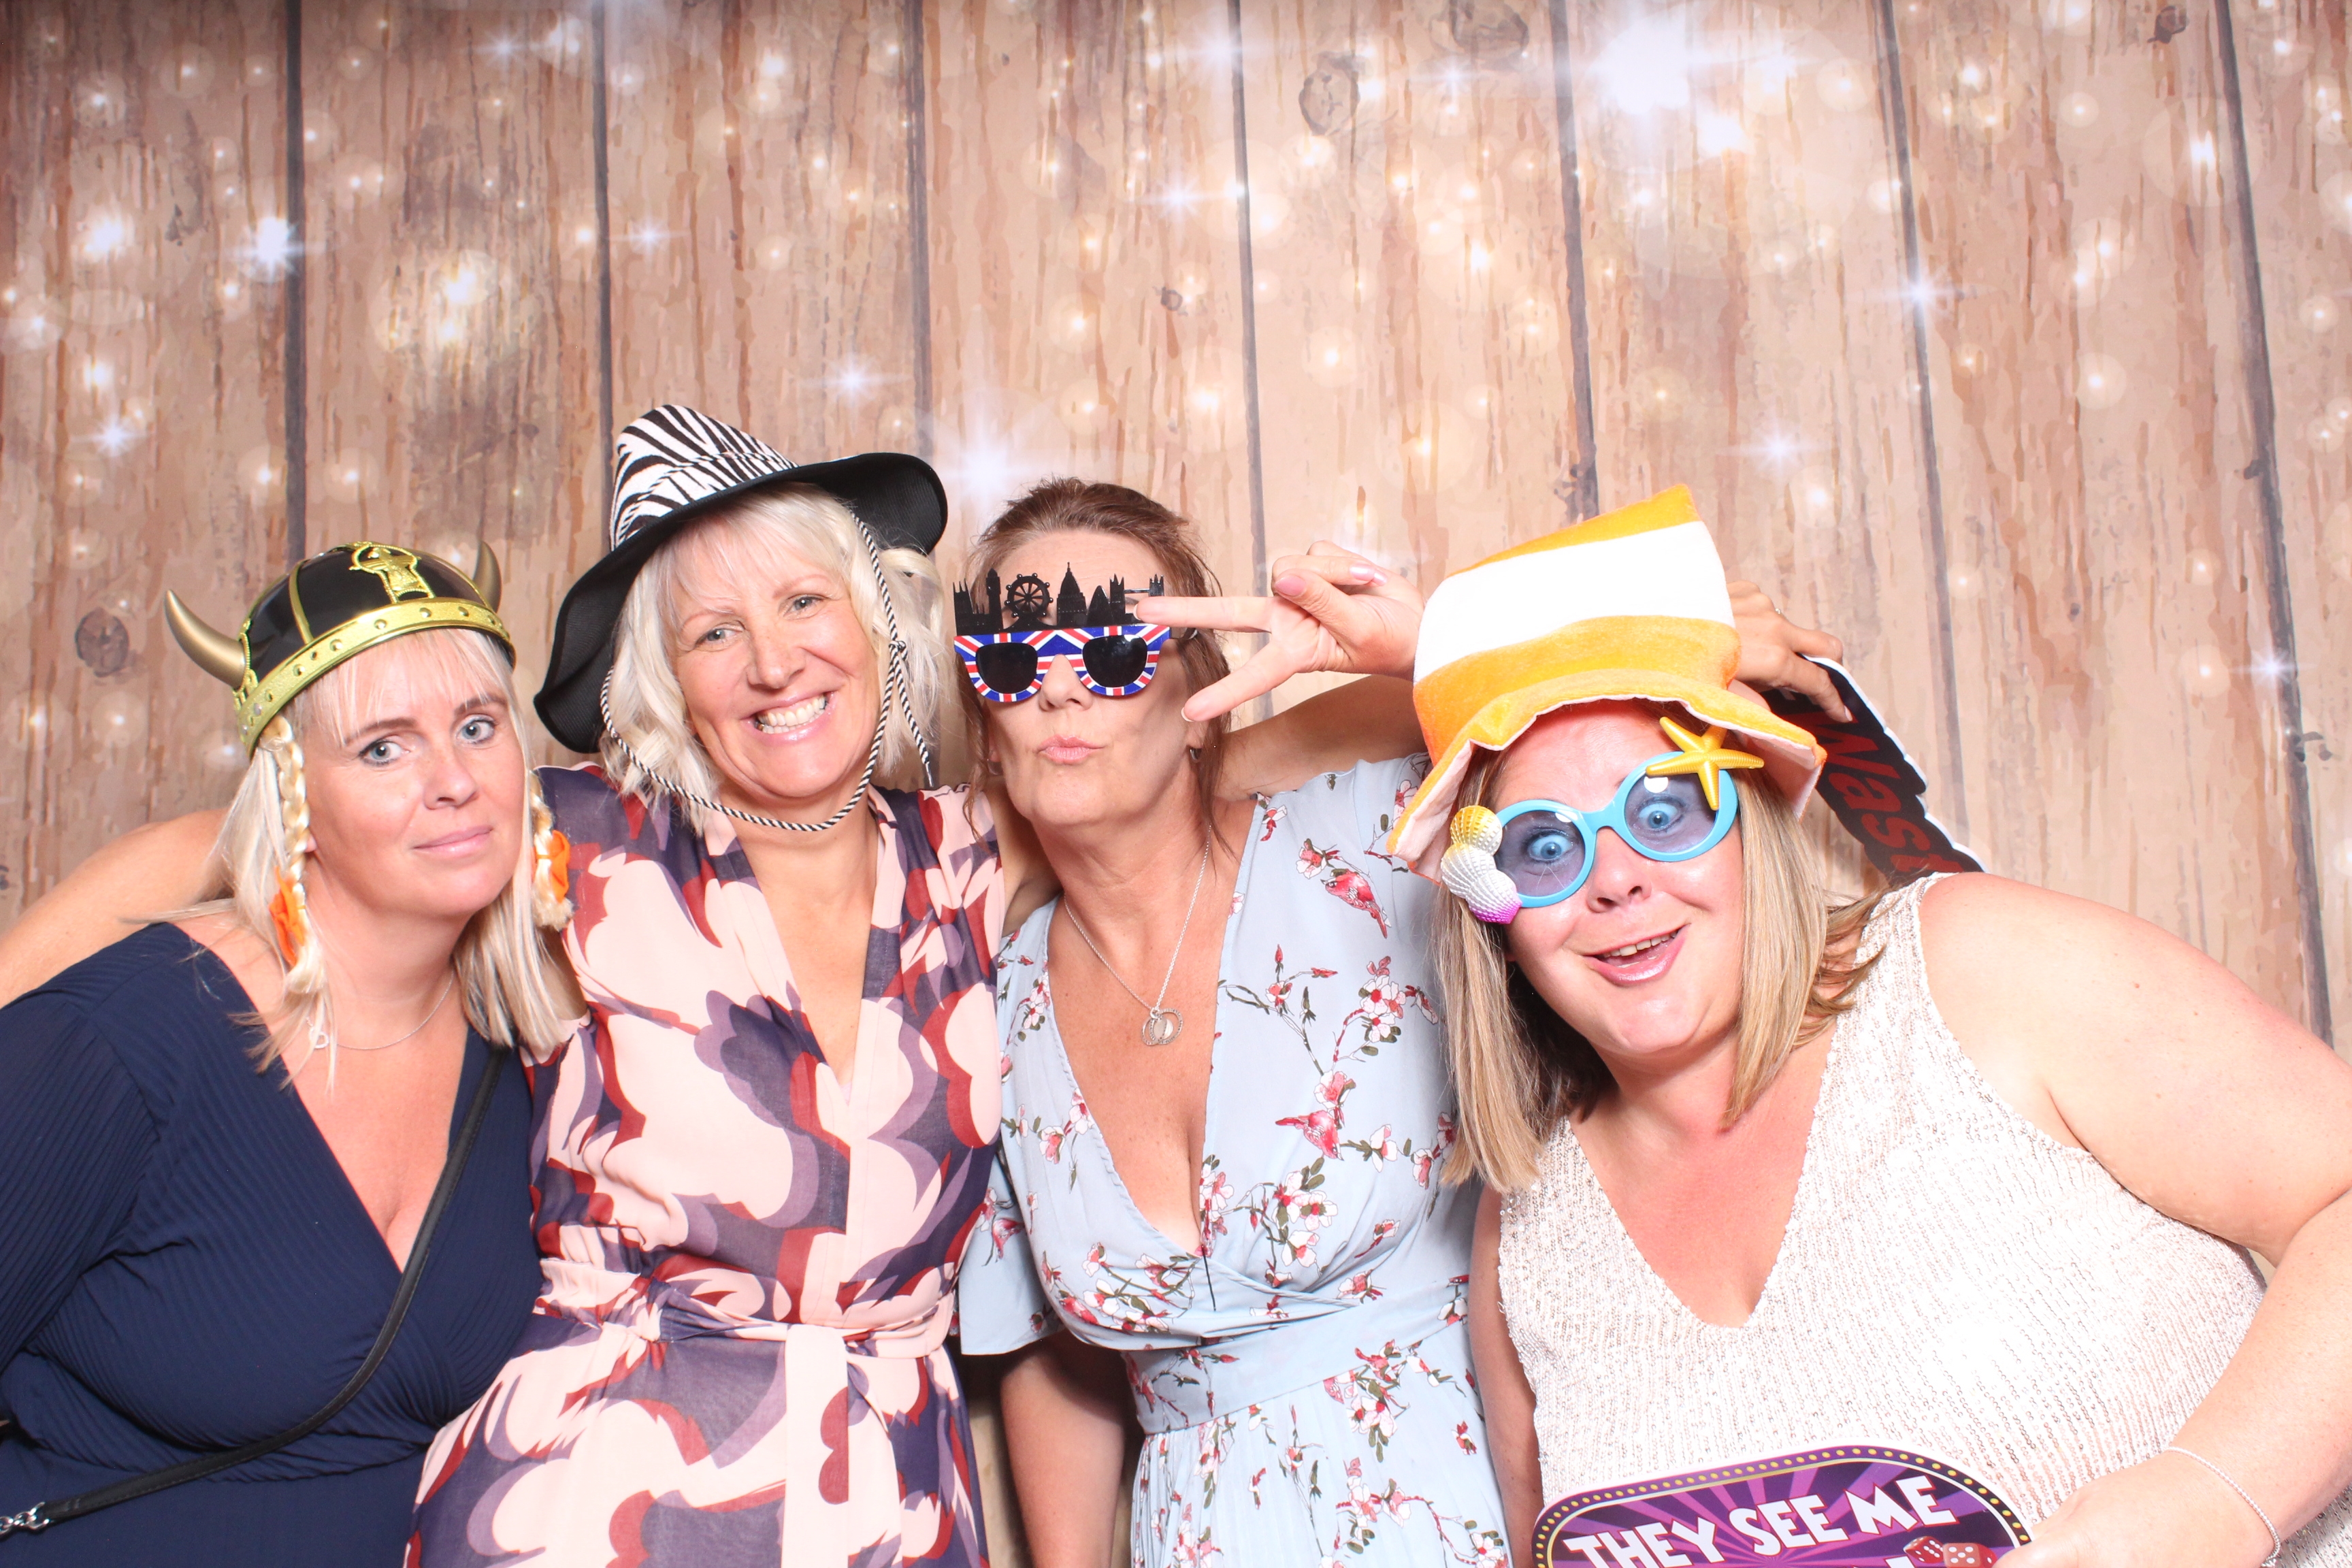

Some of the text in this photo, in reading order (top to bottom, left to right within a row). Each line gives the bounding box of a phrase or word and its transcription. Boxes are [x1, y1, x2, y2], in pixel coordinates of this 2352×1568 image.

[1563, 1475, 1959, 1568] THEY SEE ME
